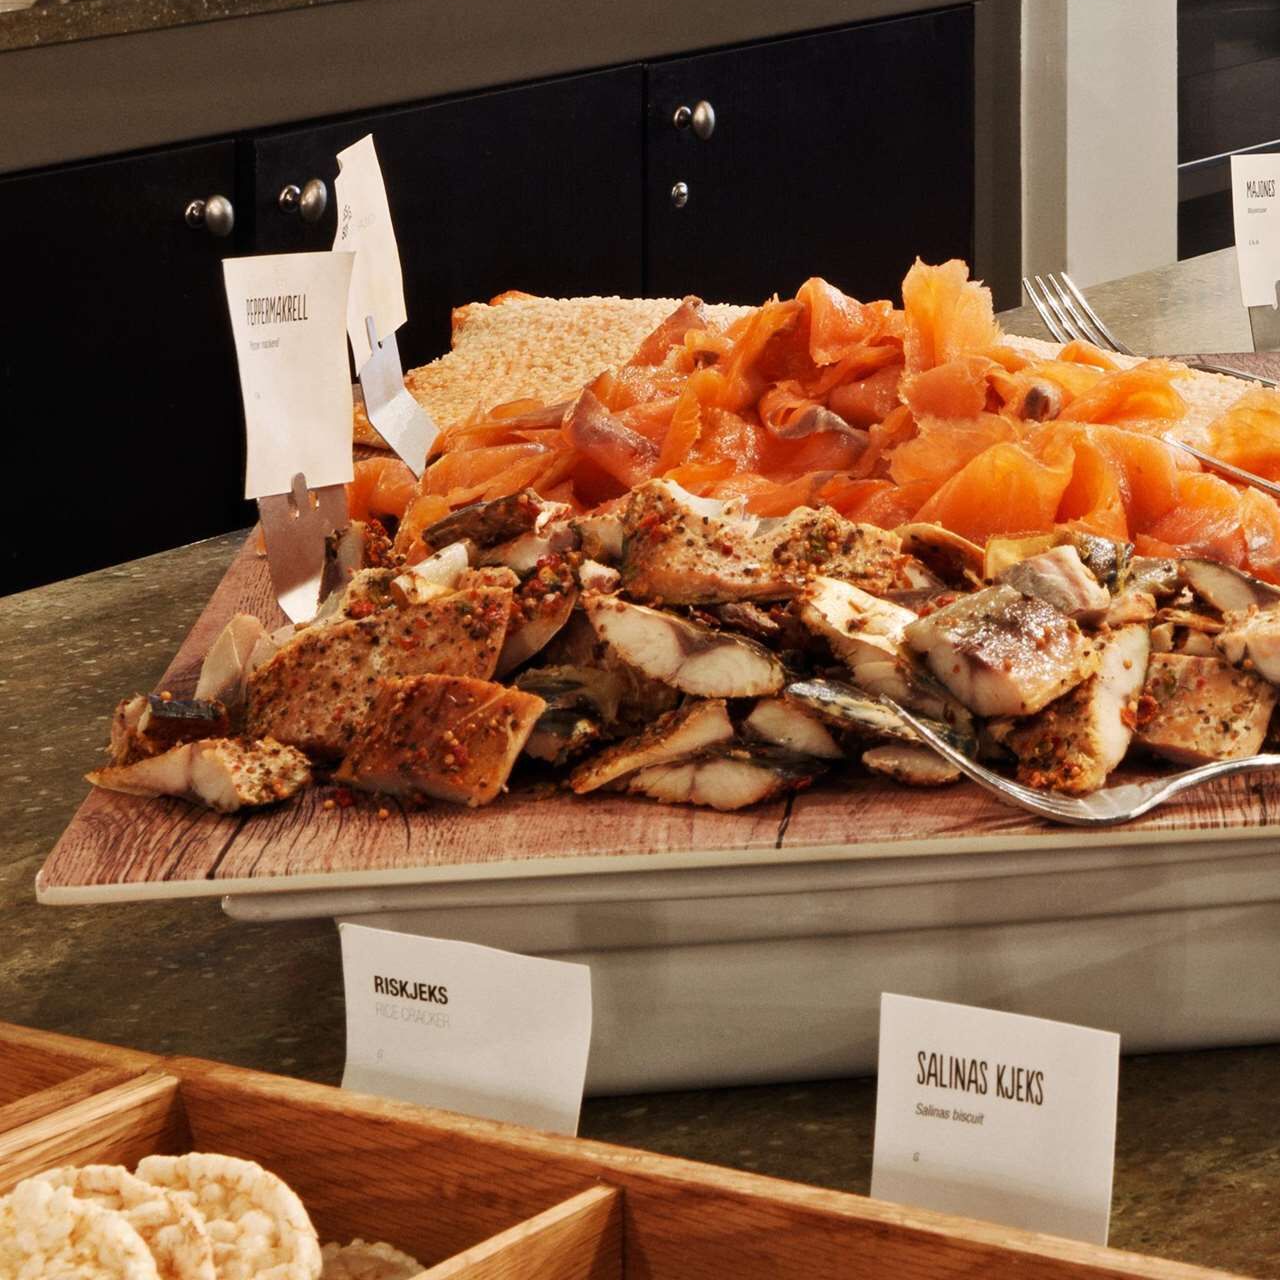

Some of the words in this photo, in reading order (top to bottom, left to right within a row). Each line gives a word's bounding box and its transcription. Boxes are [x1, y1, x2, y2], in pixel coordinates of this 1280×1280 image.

[246, 294, 308, 326] PEPPERMAKRELL
[373, 975, 449, 1005] RISKJEKS
[916, 1050, 988, 1096] SALINAS
[995, 1063, 1044, 1106] KJEKS
[915, 1102, 950, 1120] Salinas
[952, 1108, 985, 1126] biscuit
